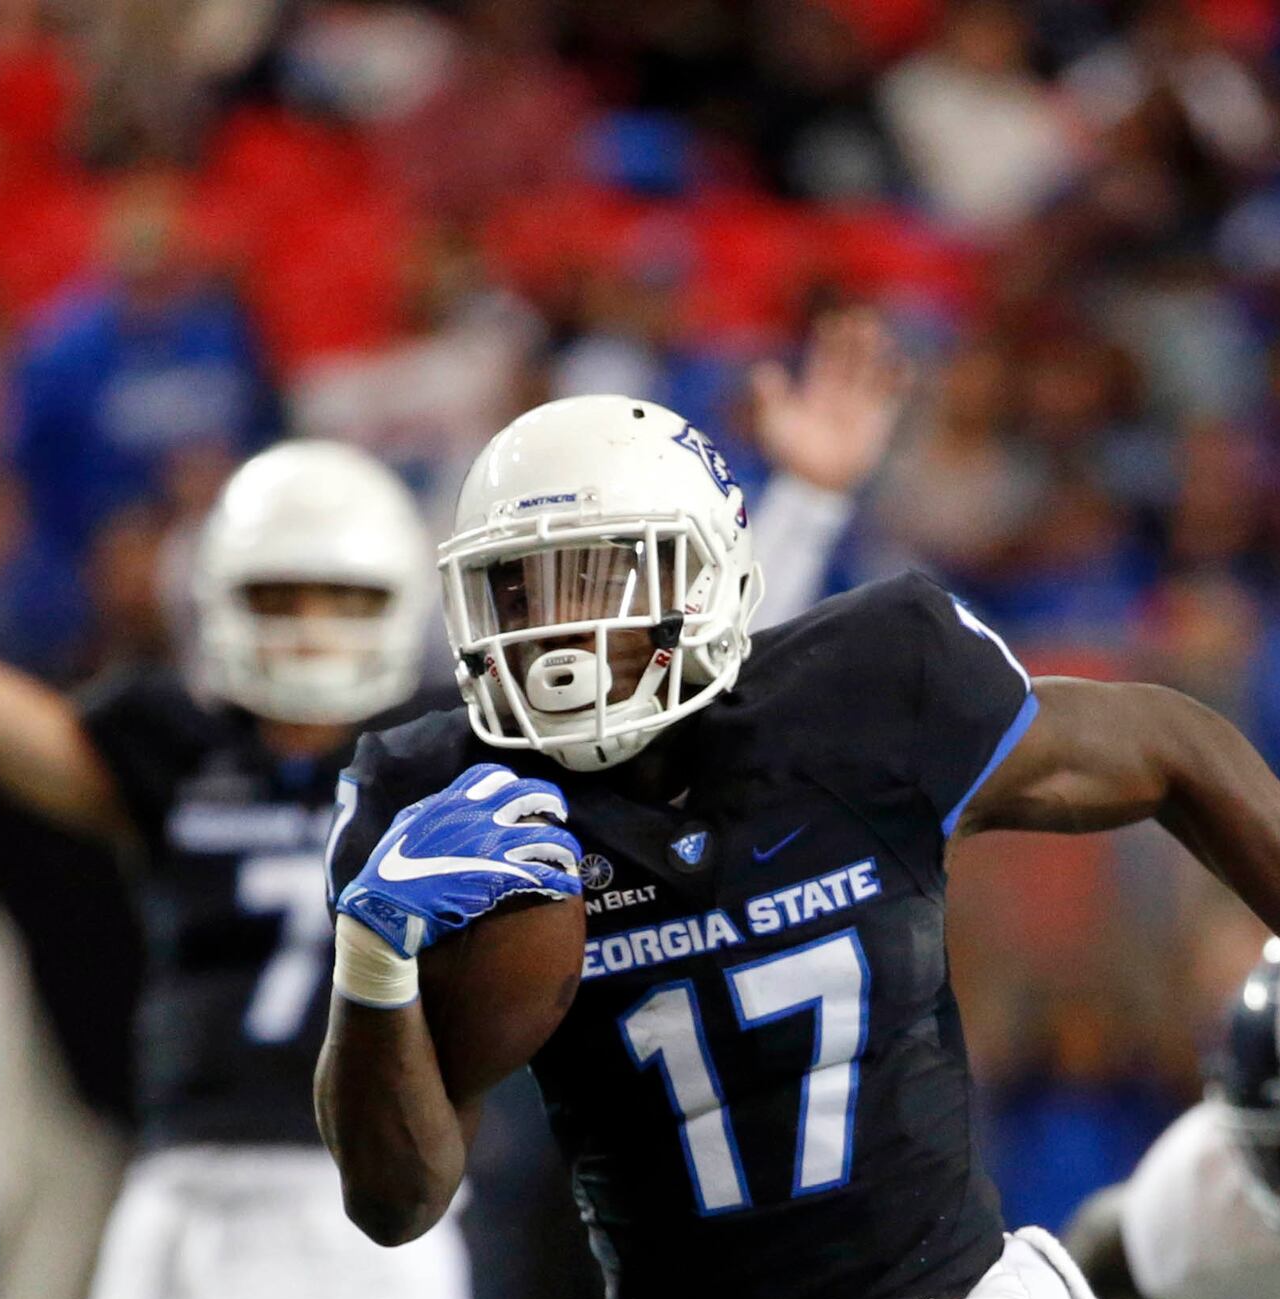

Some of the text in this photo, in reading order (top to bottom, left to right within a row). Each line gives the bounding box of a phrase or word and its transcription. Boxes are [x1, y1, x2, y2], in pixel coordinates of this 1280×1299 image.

[581, 857, 882, 979] EORGIA STATE
[603, 885, 657, 911] BELT
[618, 926, 872, 1217] 17
